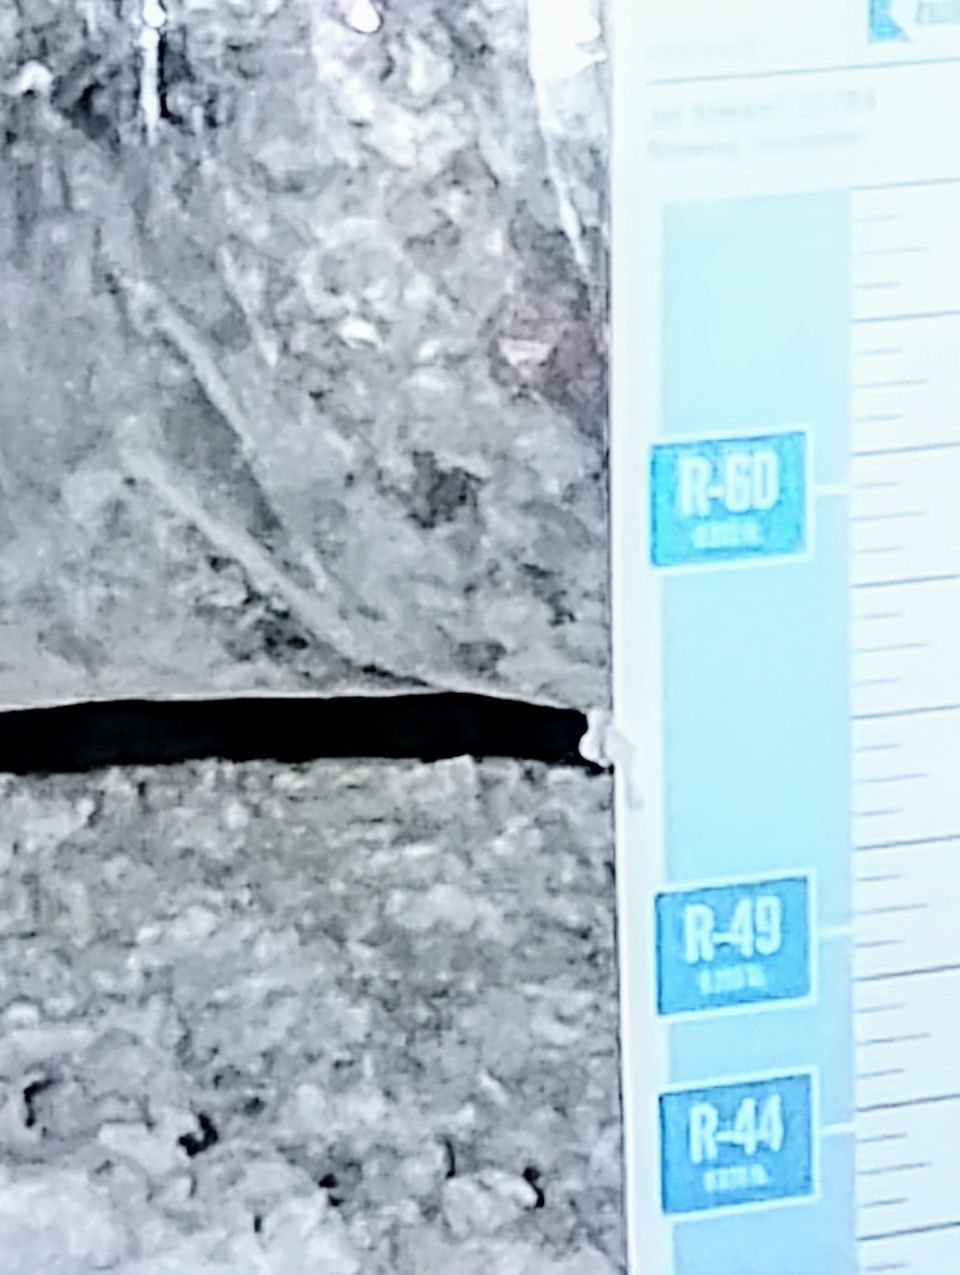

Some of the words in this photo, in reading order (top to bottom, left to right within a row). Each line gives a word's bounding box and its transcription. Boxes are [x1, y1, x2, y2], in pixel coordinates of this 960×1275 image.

[675, 449, 780, 517] R-60
[683, 895, 782, 964] R-49
[689, 1094, 785, 1163] R-44
